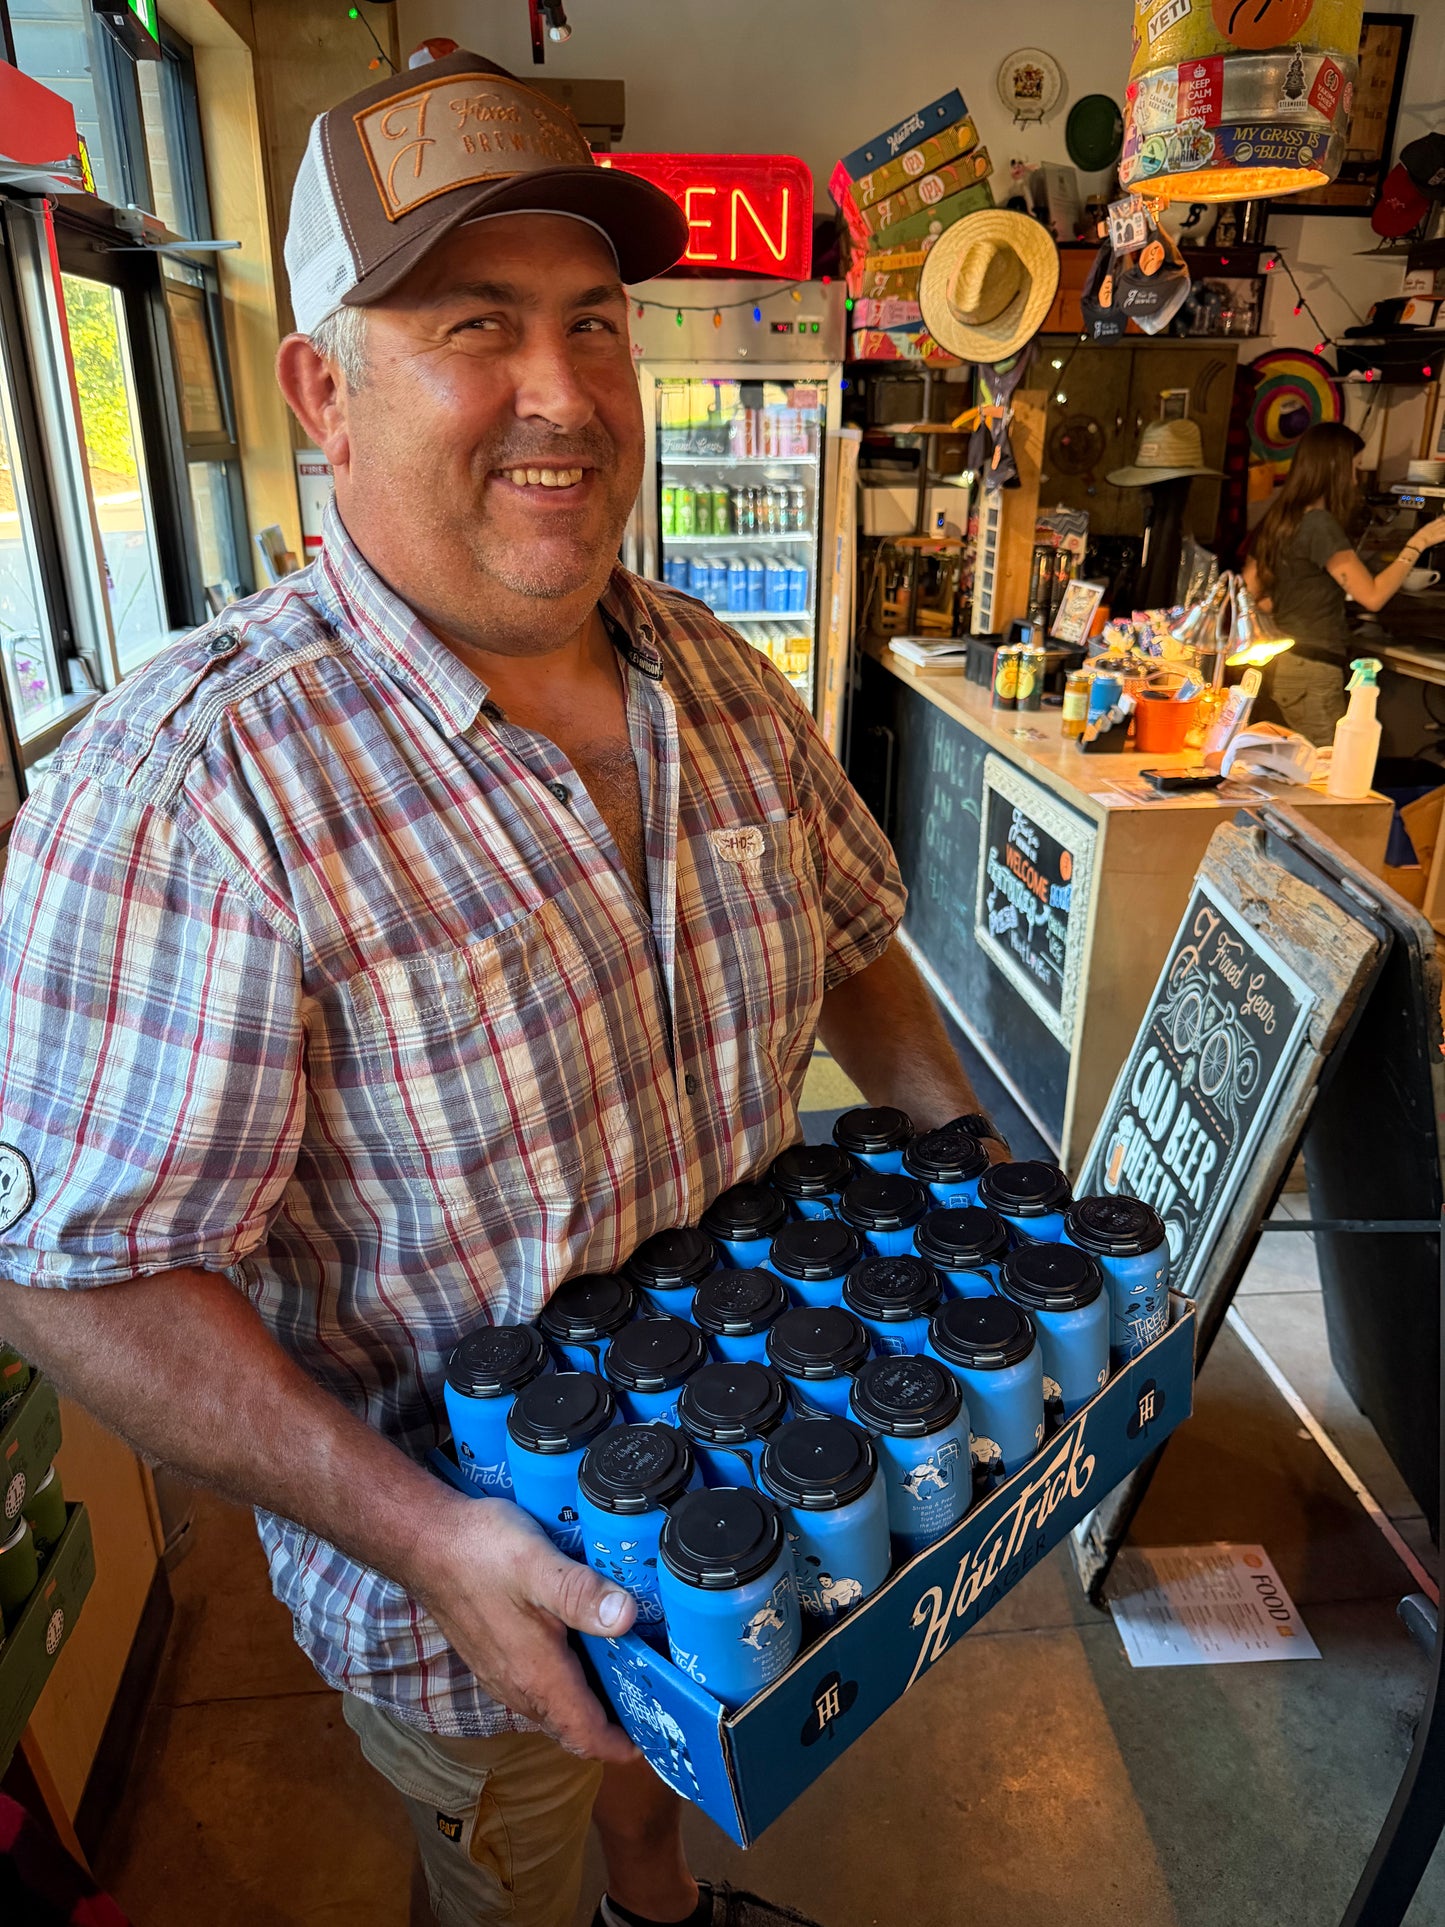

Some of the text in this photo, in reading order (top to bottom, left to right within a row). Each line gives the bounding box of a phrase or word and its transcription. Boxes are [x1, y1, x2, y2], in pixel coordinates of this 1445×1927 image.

[1150, 0, 1186, 36] YETI
[1187, 88, 1212, 100] CALM
[1189, 78, 1210, 91] KEEP
[1183, 104, 1213, 117] ROVER
[1232, 127, 1320, 148] MY GRASS IS
[1254, 145, 1297, 160] BLUE
[904, 153, 923, 173] IPA
[922, 178, 943, 203] IPA
[685, 187, 788, 261] EN
[1005, 843, 1049, 903] WELCOME
[1207, 931, 1276, 1035] Fixed Gear
[1131, 1046, 1218, 1212] COLD BEER
[1128, 1307, 1165, 1340] THREE
[1250, 1574, 1291, 1622] FOOD
[611, 1666, 646, 1704] THREE
[619, 1691, 661, 1733] CHEERS!
[439, 1818, 460, 1837] CAT
